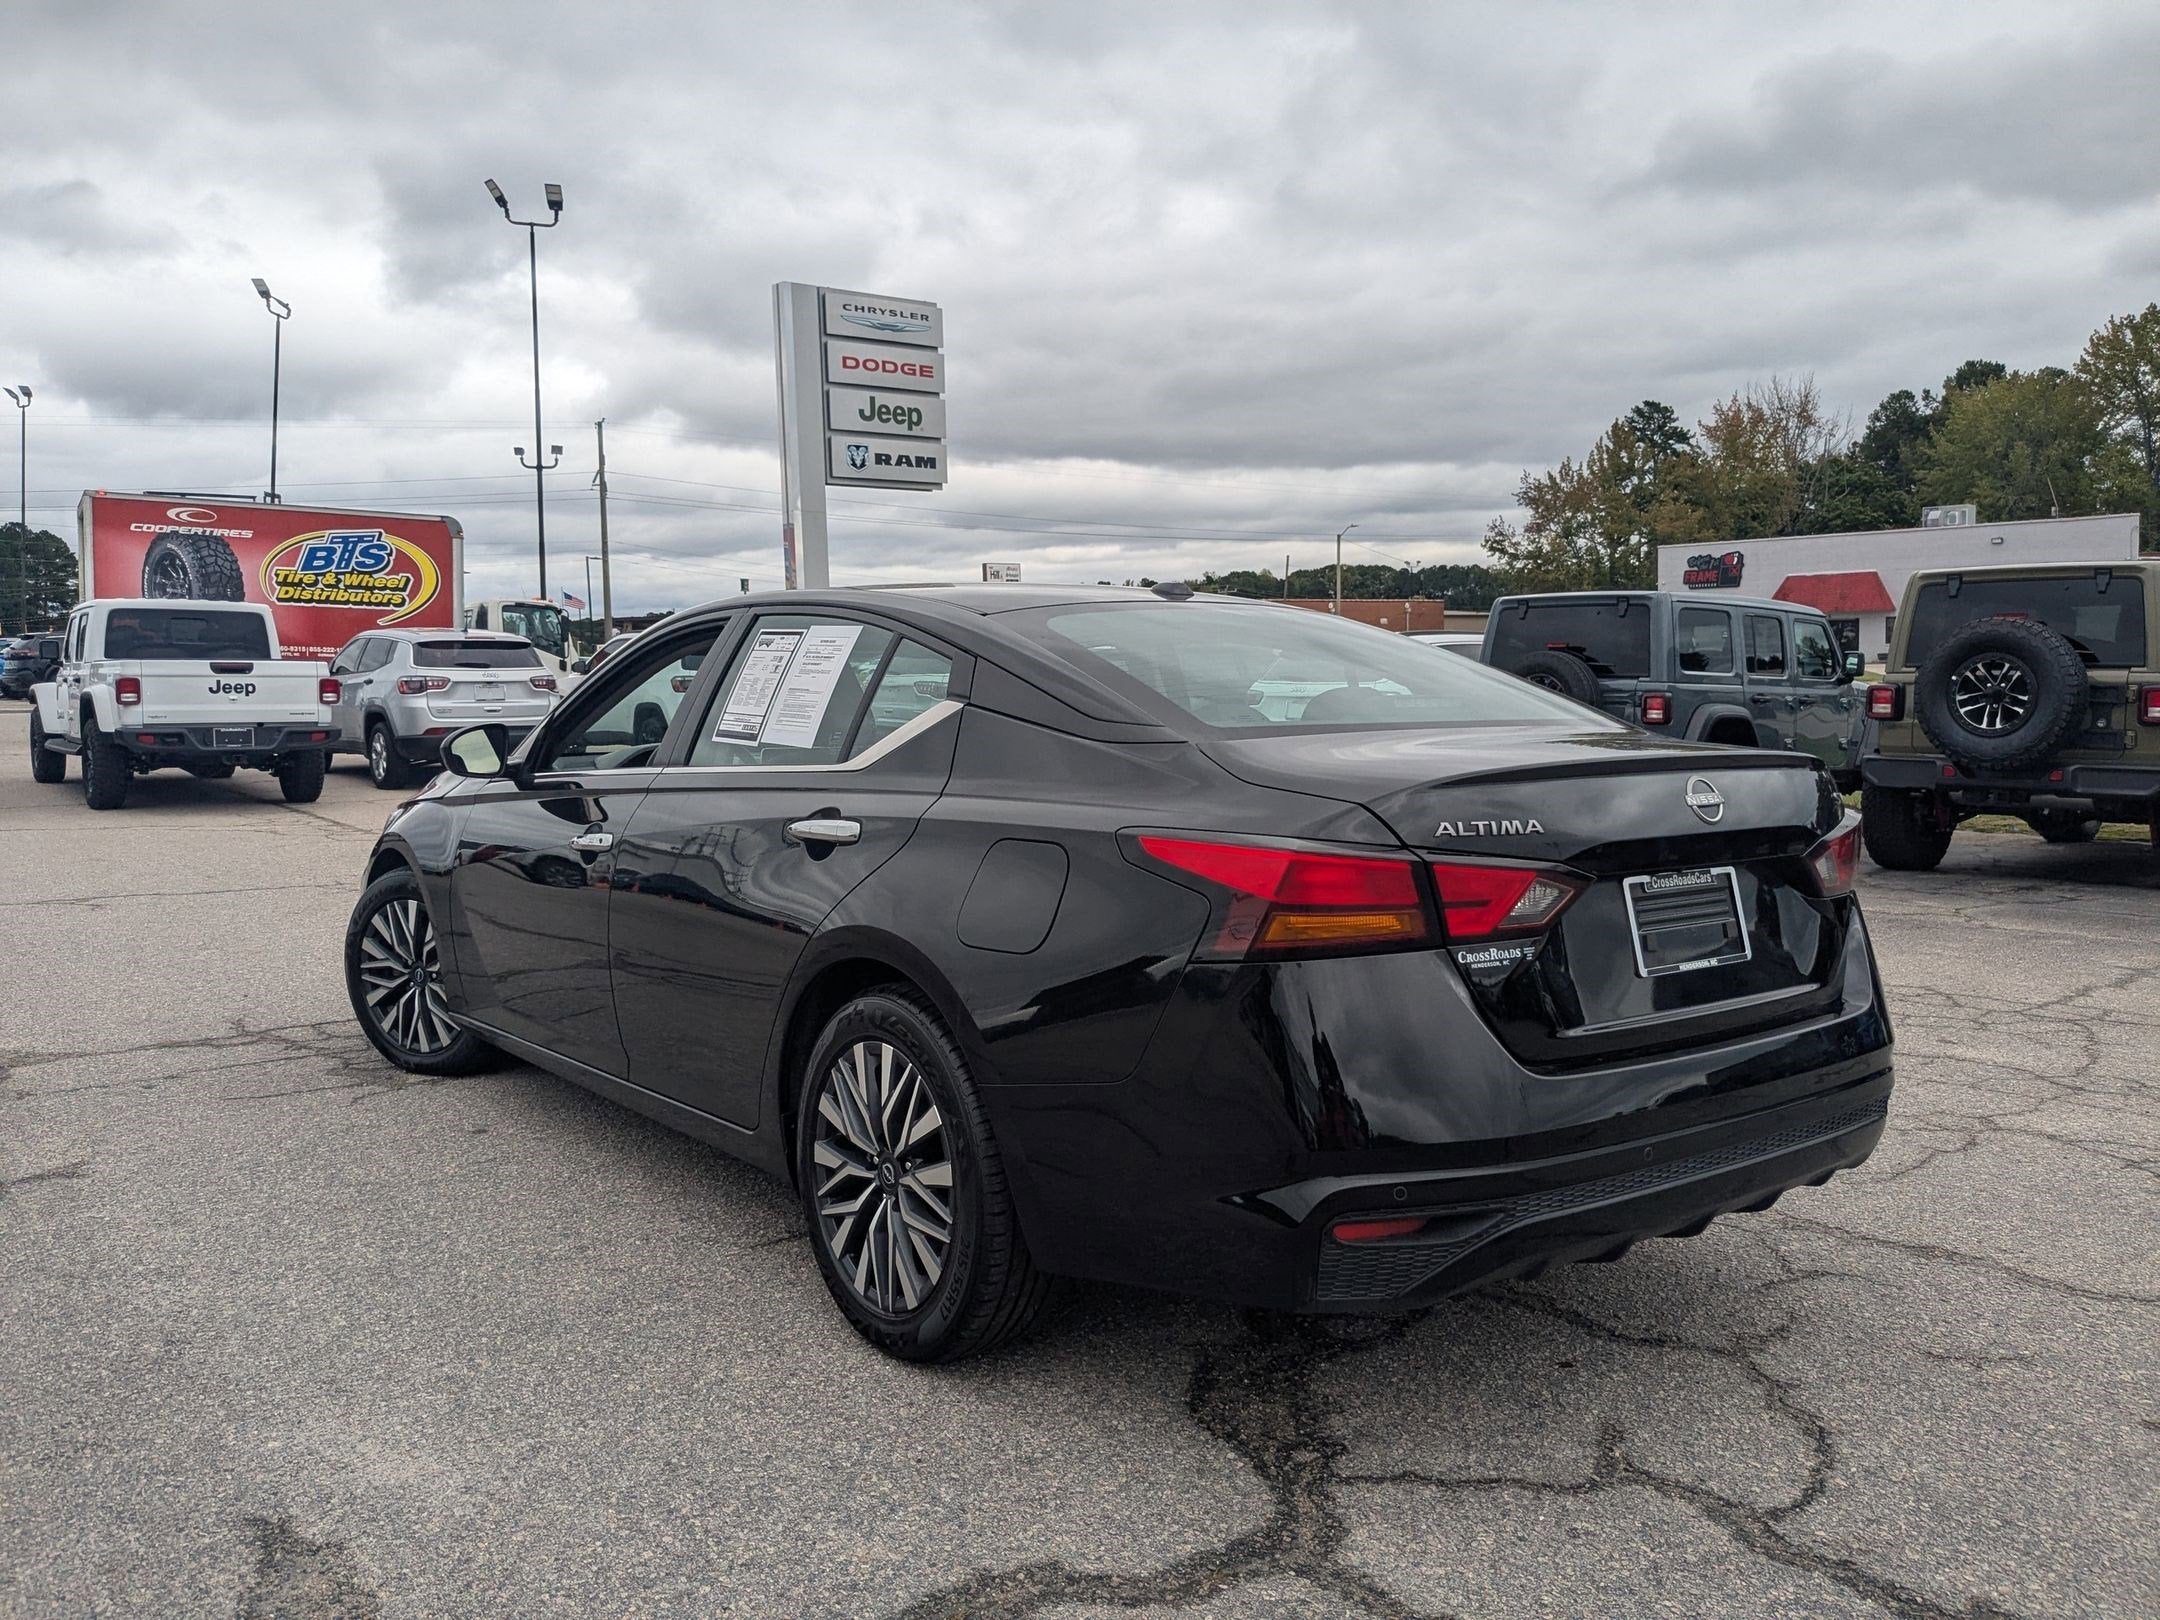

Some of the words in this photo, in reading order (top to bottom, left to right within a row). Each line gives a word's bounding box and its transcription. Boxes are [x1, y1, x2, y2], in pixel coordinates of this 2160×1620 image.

[842, 304, 930, 321] CHRYSLER
[842, 356, 934, 378] DODGE
[859, 396, 922, 431] Jeep
[874, 452, 937, 470] RAM
[299, 533, 391, 573] BTS
[276, 570, 316, 583] Tire
[321, 572, 338, 586] &
[344, 573, 407, 588] Wheel
[1684, 570, 1719, 584] FRAME
[278, 586, 403, 604] Distributors
[208, 680, 257, 696] Jeep
[1434, 819, 1545, 837] ALTIMA
[1652, 872, 1711, 888] CrossRoadsCars
